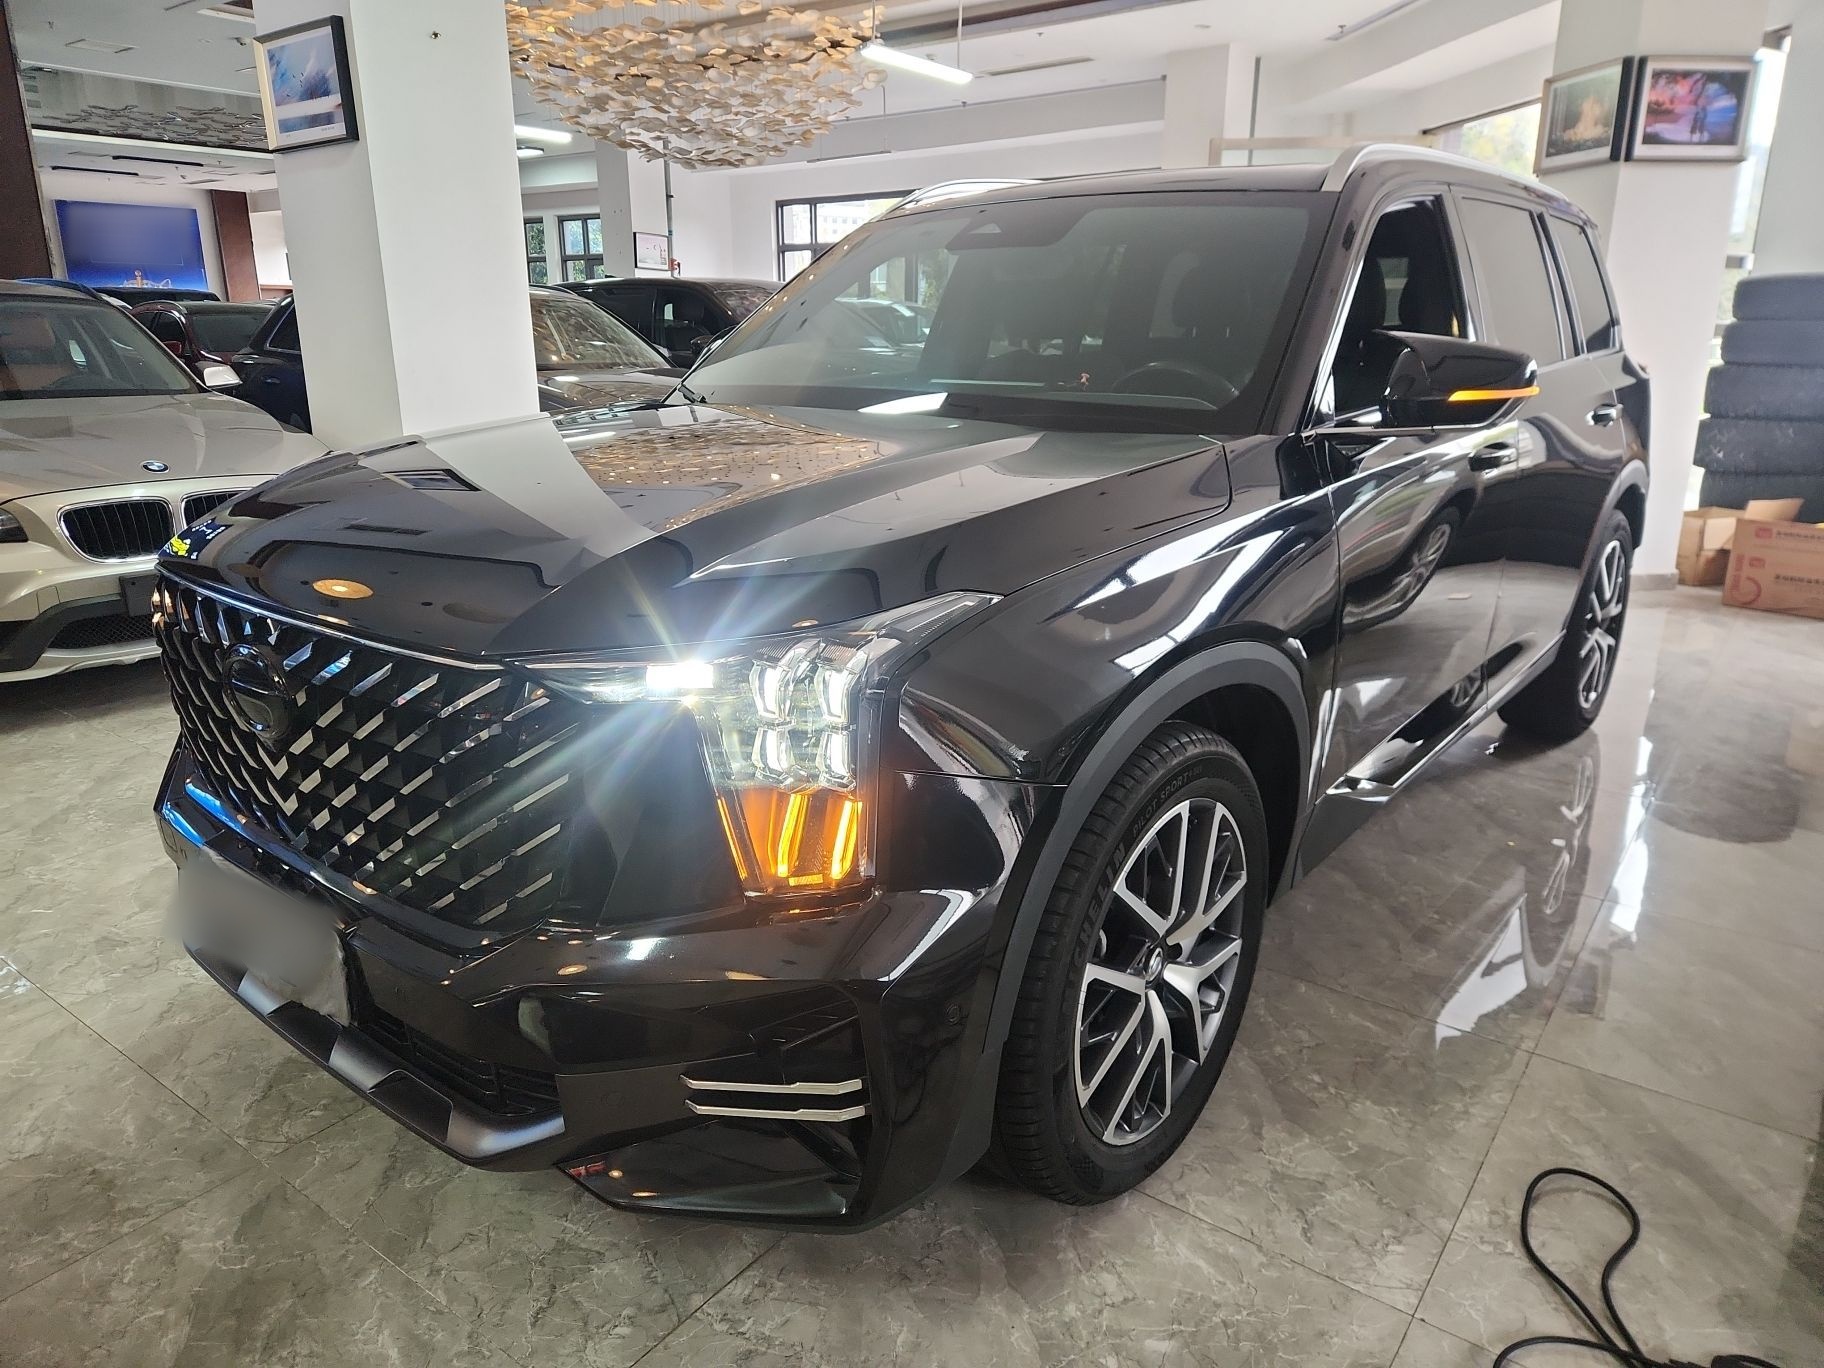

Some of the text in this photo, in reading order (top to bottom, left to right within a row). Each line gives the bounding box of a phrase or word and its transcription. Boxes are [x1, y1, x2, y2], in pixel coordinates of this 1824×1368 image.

[1132, 773, 1189, 837] PILOT SPORT
[1061, 842, 1127, 1015] CHELIN
